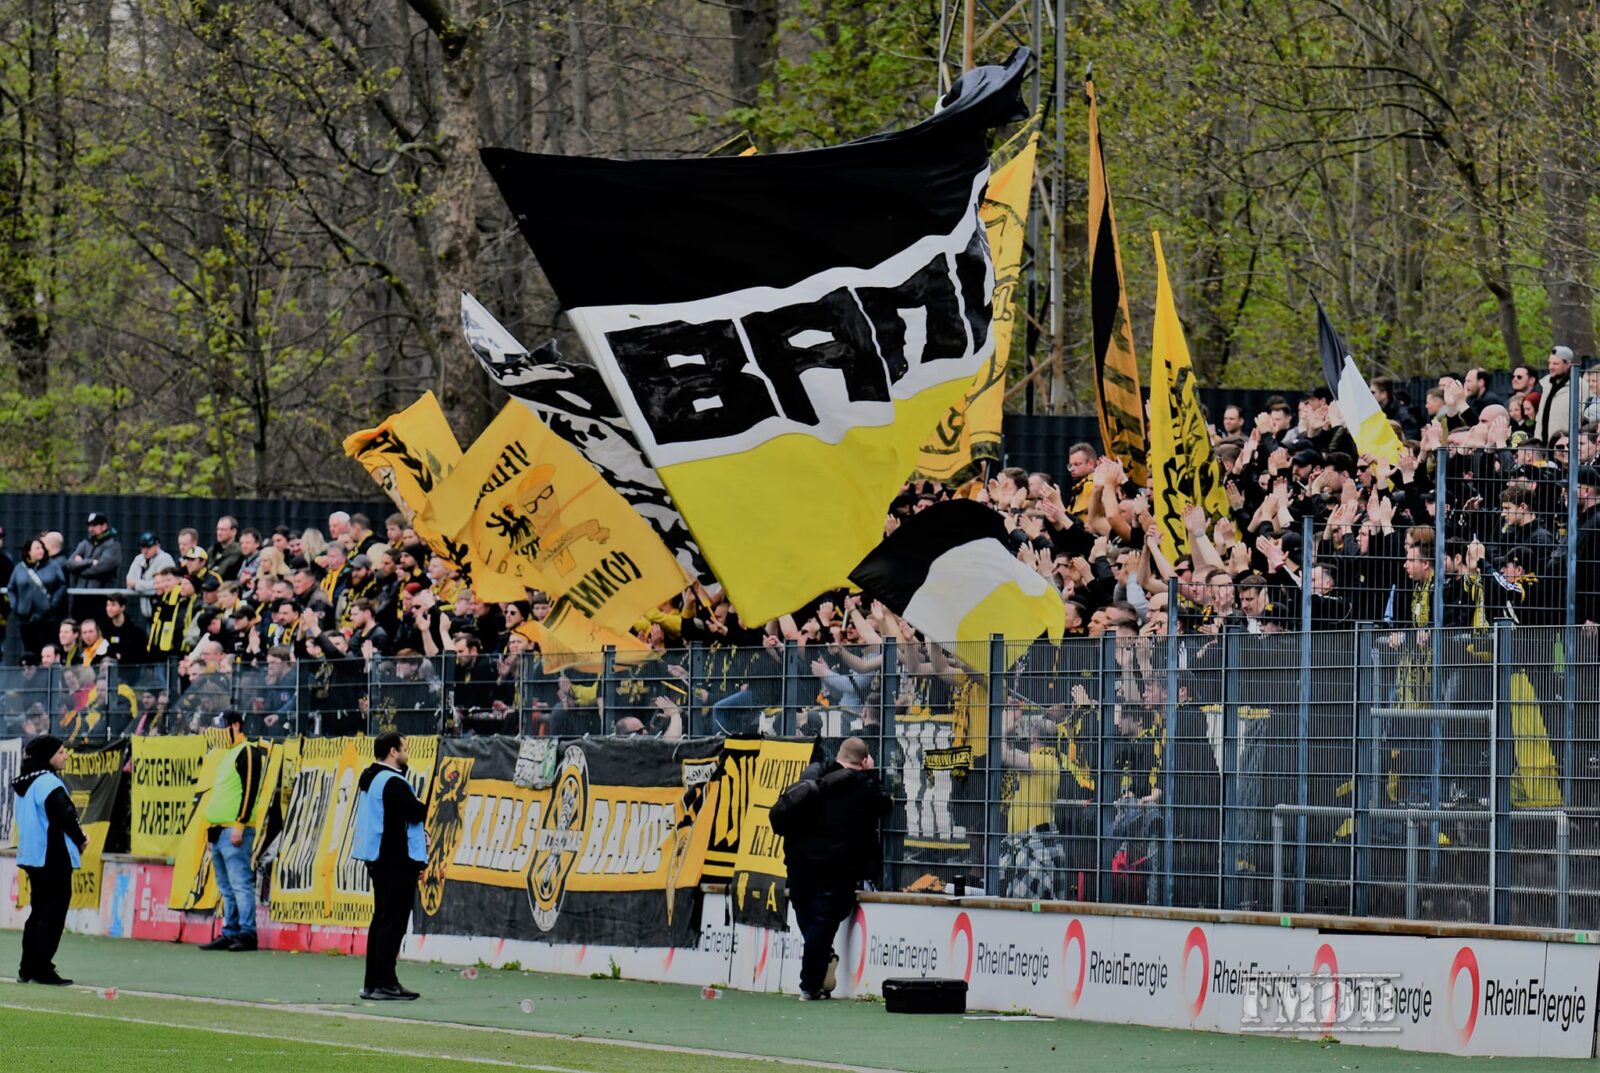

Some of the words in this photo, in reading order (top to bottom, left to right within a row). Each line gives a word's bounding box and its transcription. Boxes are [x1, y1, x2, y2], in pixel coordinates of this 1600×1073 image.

[453, 794, 541, 872] KARLS
[869, 935, 938, 978] RheinEnergie
[977, 942, 1050, 985] RheinEnergie
[1090, 950, 1168, 996] RheinEnergie
[1484, 979, 1586, 1032] RheinEnergie
